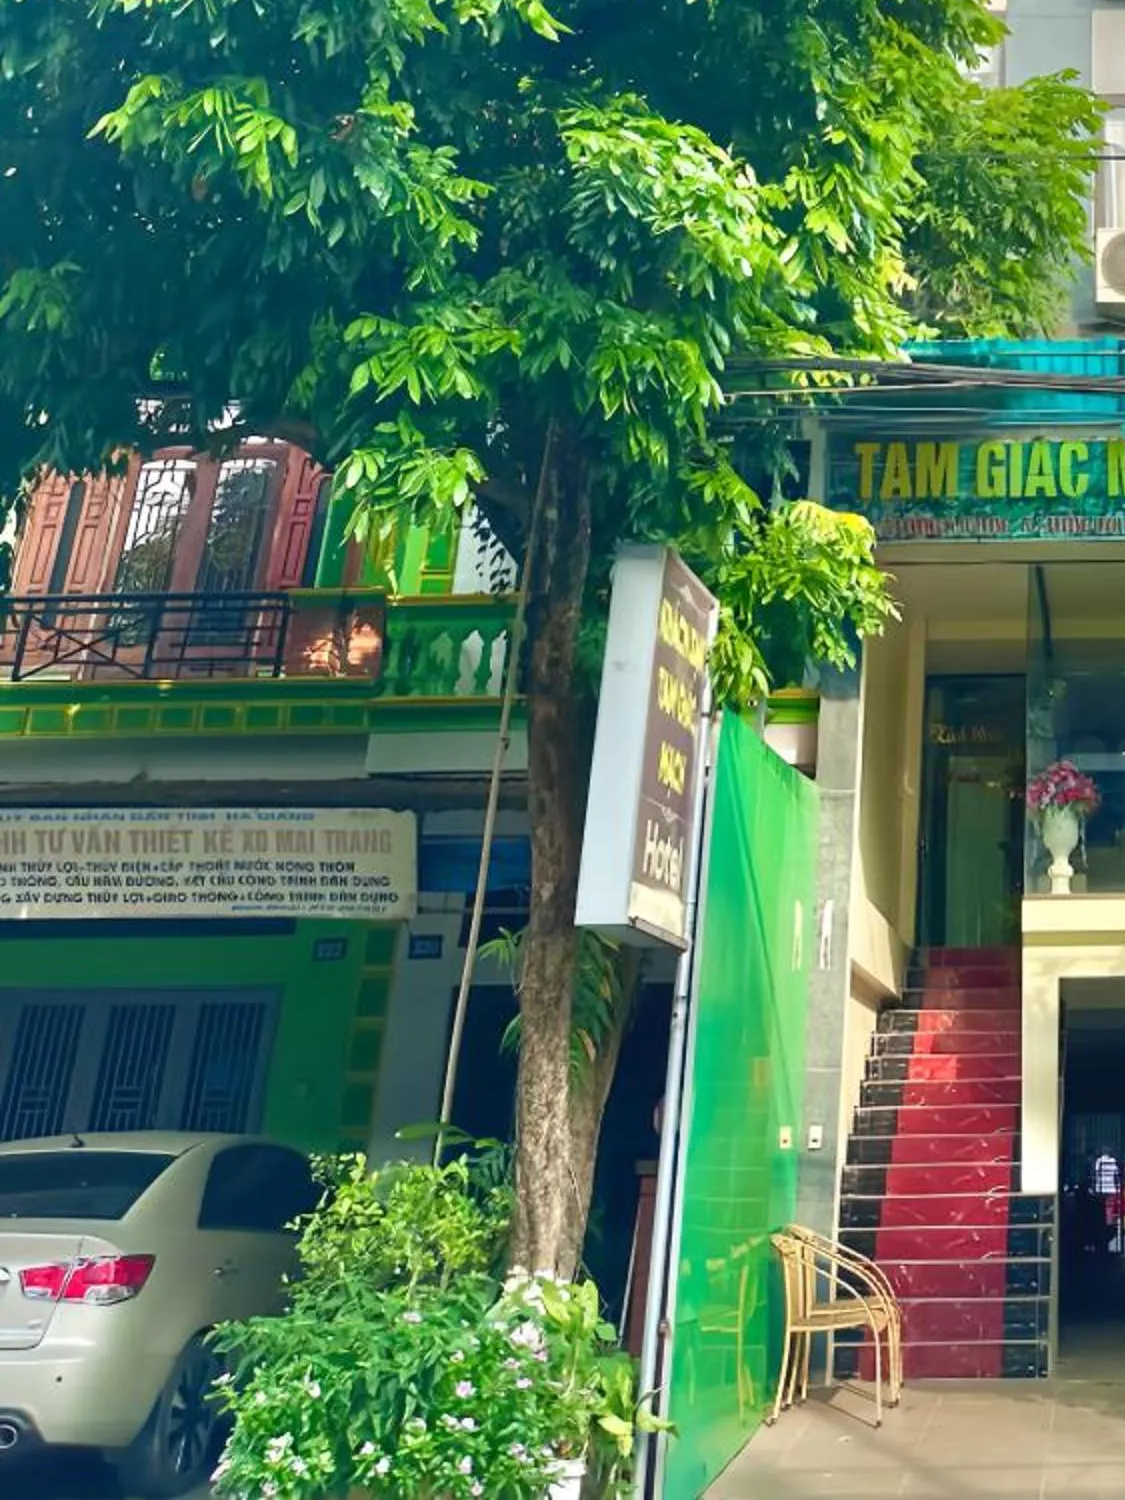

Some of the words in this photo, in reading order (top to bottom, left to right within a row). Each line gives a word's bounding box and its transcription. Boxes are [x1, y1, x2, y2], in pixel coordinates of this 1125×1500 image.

[855, 442, 959, 499] TAM
[276, 828, 316, 854] MAI
[322, 828, 392, 854] TRANG
[642, 818, 685, 893] Hotel
